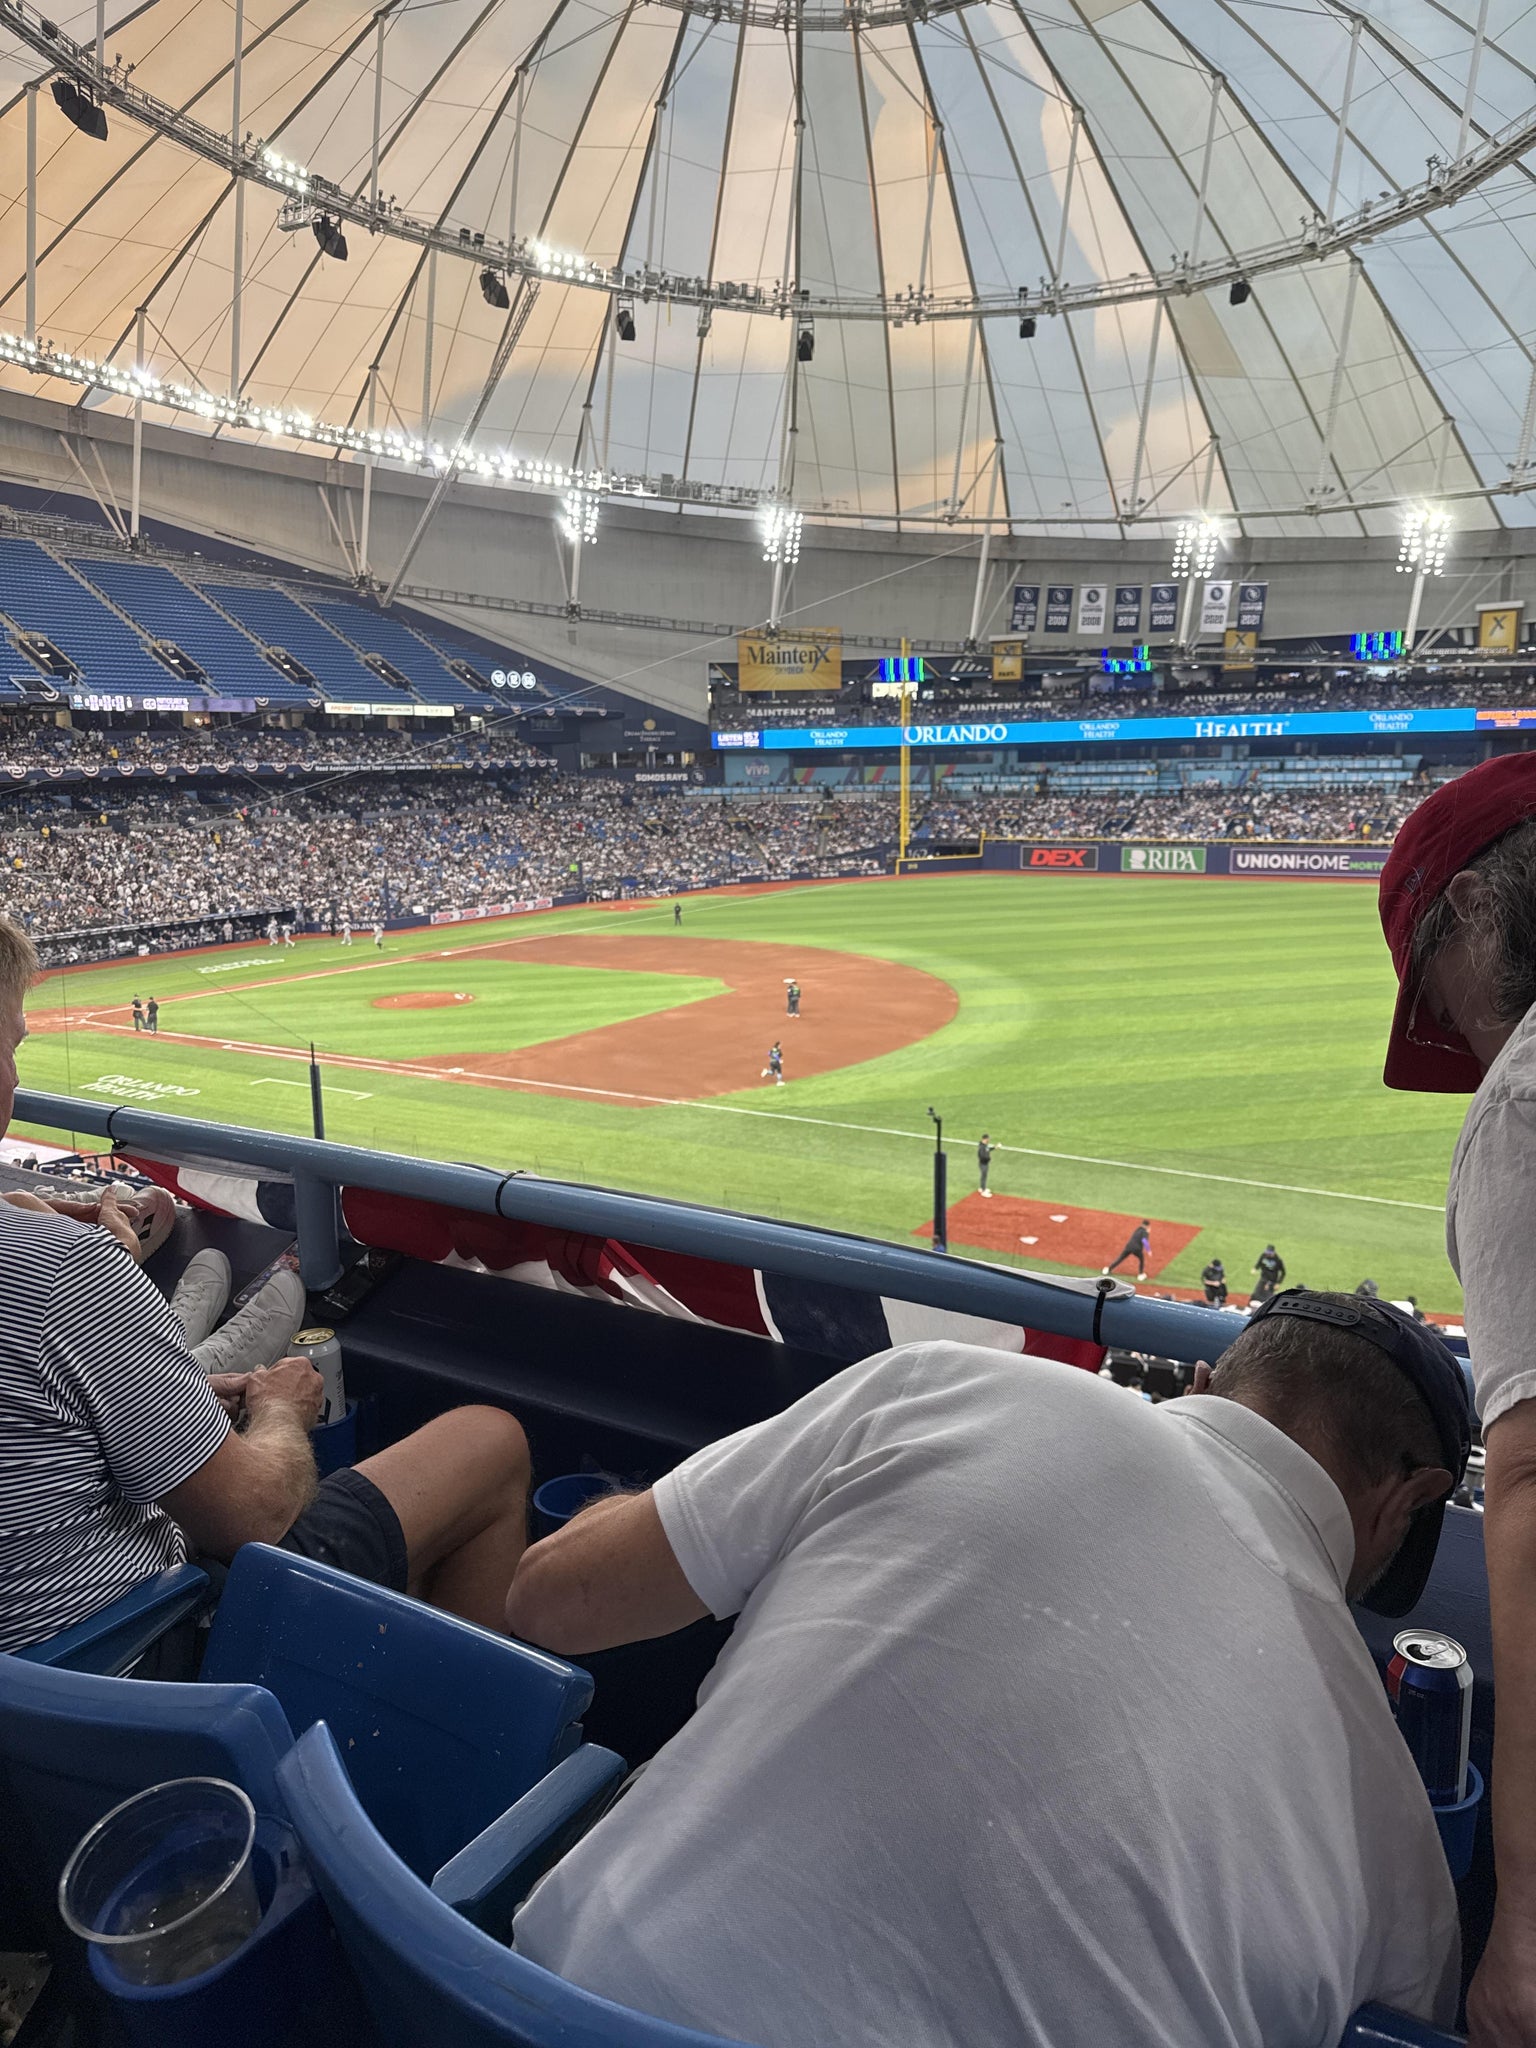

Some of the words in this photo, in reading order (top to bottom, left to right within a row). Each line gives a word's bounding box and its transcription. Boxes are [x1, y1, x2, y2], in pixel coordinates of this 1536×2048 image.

[746, 644, 832, 673] MaintenX
[1369, 712, 1414, 722] ORLANDO
[1079, 722, 1120, 731] ORLANDO
[1373, 721, 1409, 731] HEALTH
[810, 730, 848, 739] ORLANDO
[904, 724, 1008, 744] ORLANDO
[1083, 730, 1115, 739] HEALTH
[814, 738, 844, 746] HEALTH
[744, 766, 770, 776] VIVA
[635, 773, 665, 782] SOMOS
[666, 773, 688, 781] RAYS
[1030, 849, 1088, 867] DEX
[1148, 849, 1198, 870] RIPA
[98, 1074, 201, 1096] ORLANDO
[78, 1082, 166, 1101] HEALTH
